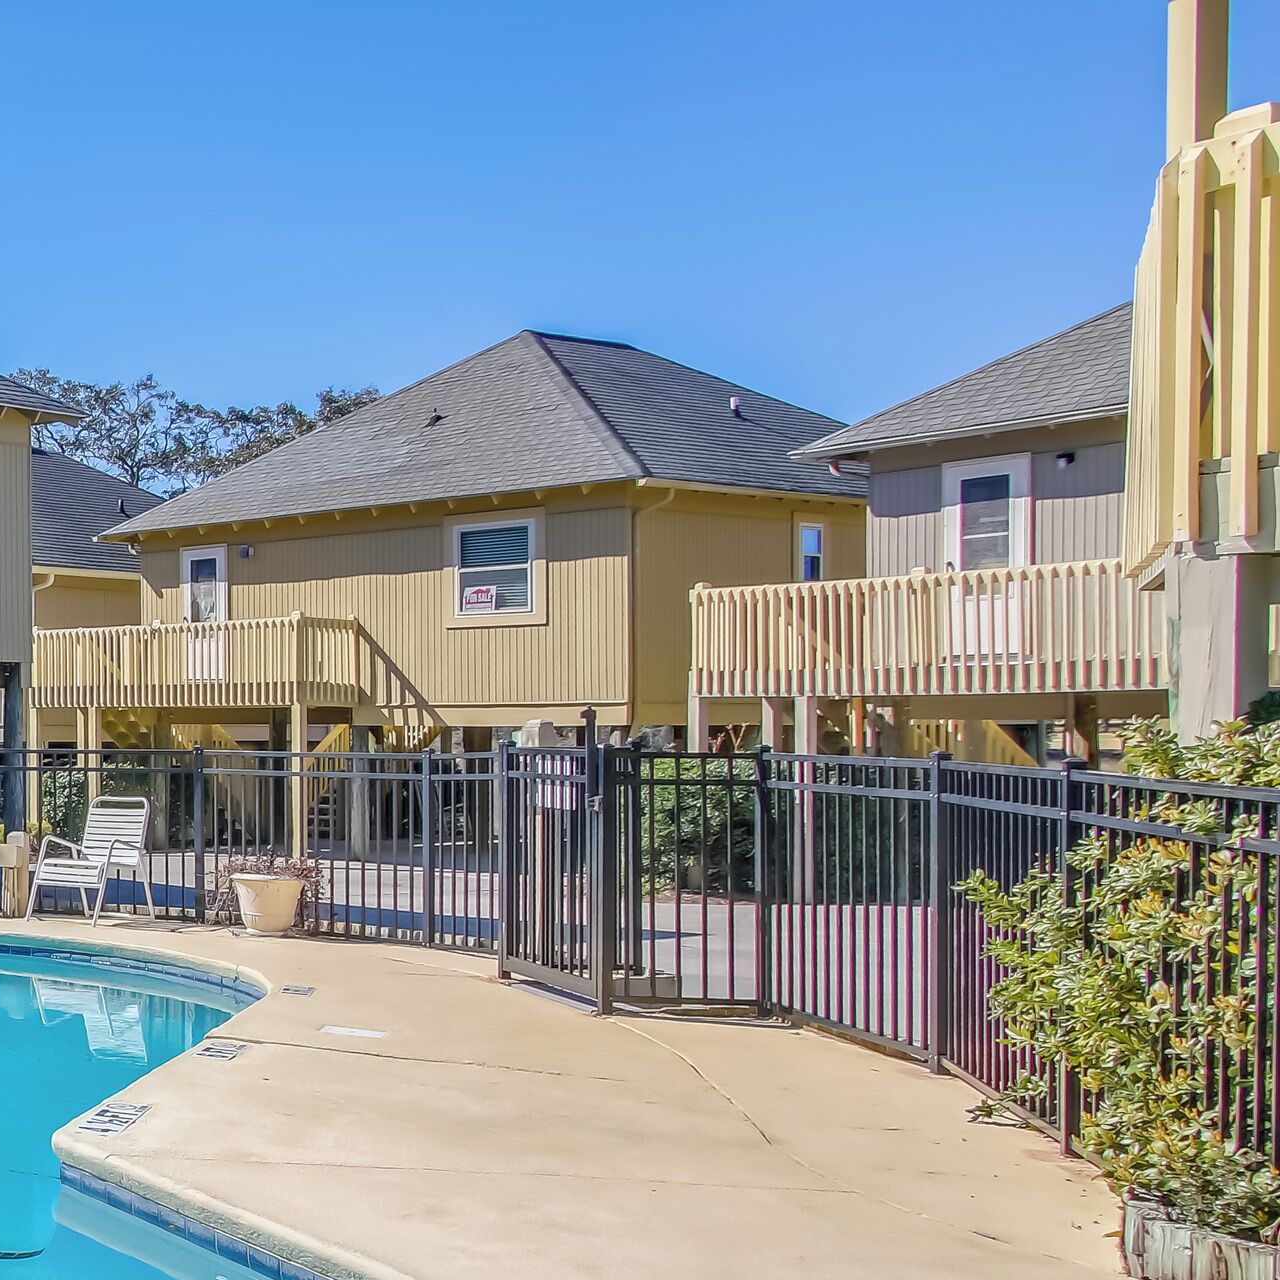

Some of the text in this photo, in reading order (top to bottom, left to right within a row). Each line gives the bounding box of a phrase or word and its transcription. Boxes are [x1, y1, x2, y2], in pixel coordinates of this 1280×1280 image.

[466, 592, 492, 602] FOR SALE
[95, 1109, 138, 1120] FT
